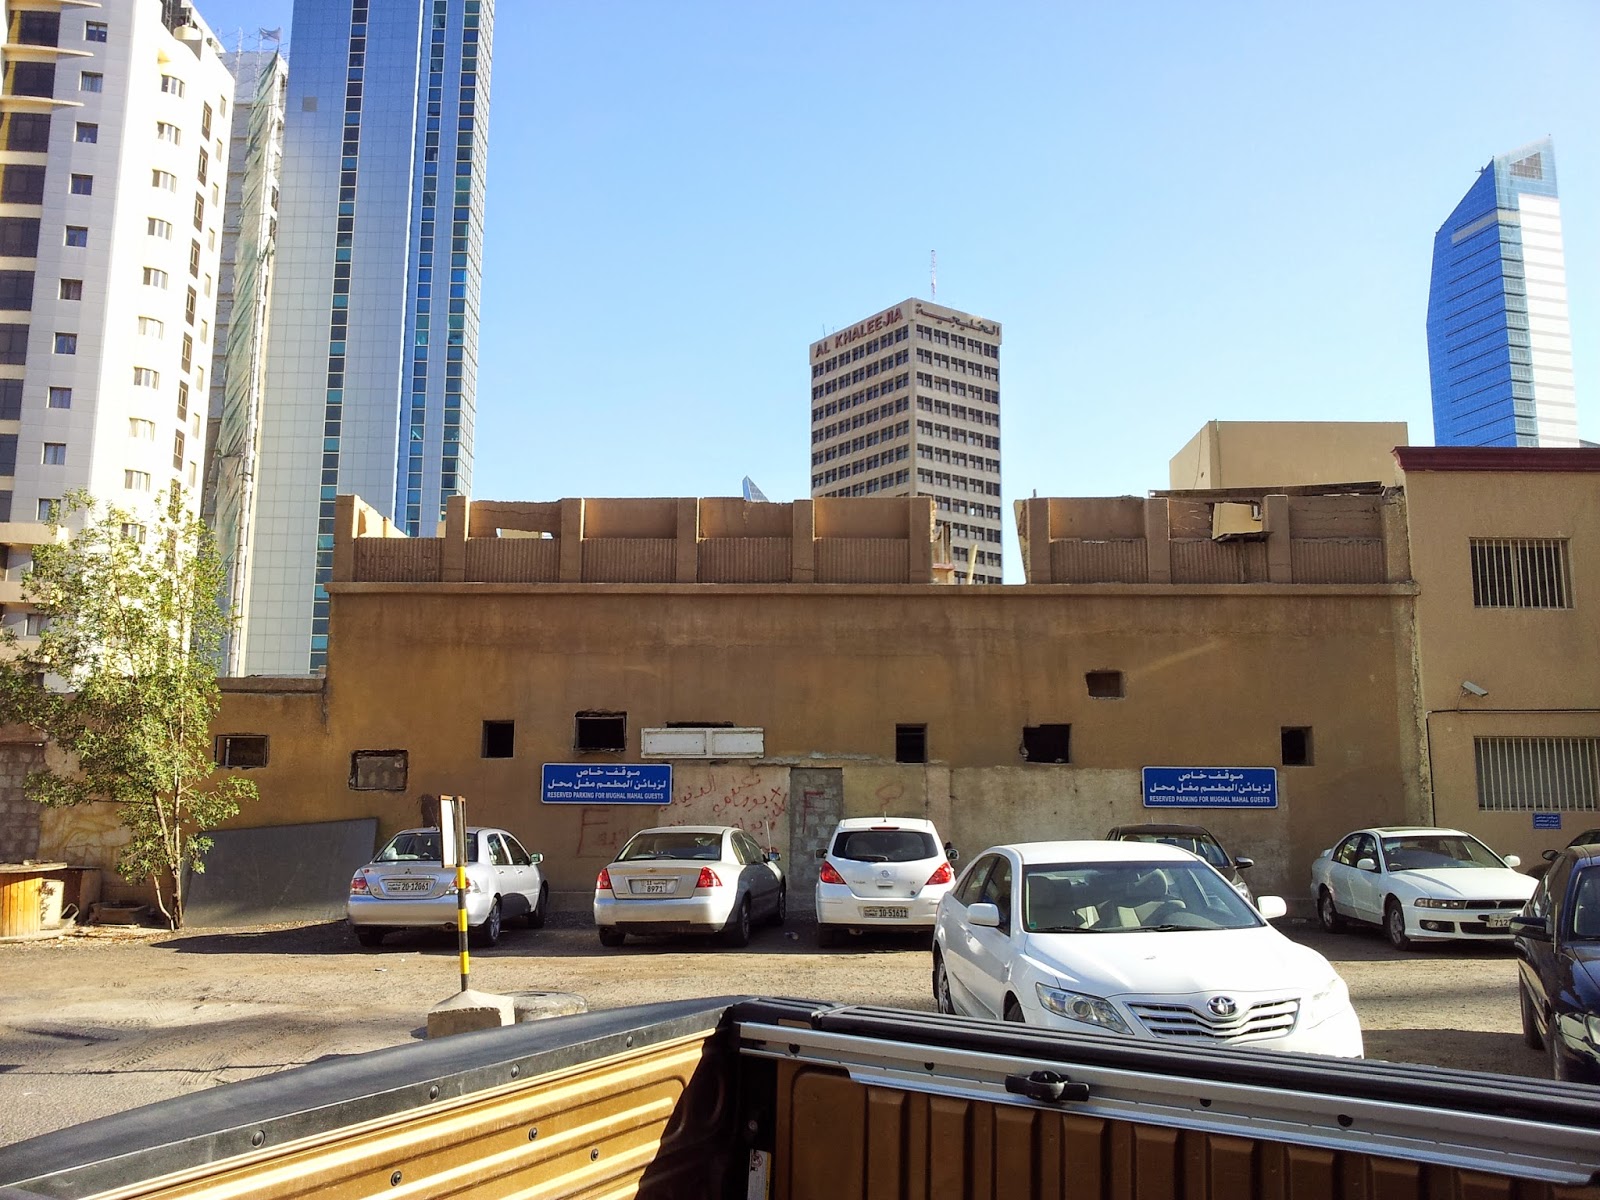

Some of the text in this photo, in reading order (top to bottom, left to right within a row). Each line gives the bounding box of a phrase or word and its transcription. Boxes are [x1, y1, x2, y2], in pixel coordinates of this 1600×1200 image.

[816, 307, 903, 358] AL KHALEEJIA
[576, 766, 640, 778] موقف خاص
[1178, 770, 1244, 782] موقف خاص
[548, 778, 666, 790] لزبائن المطعم مغل محل
[1150, 782, 1271, 794] لزبائن المطعم مغل محل
[879, 909, 907, 918] 10-51611
